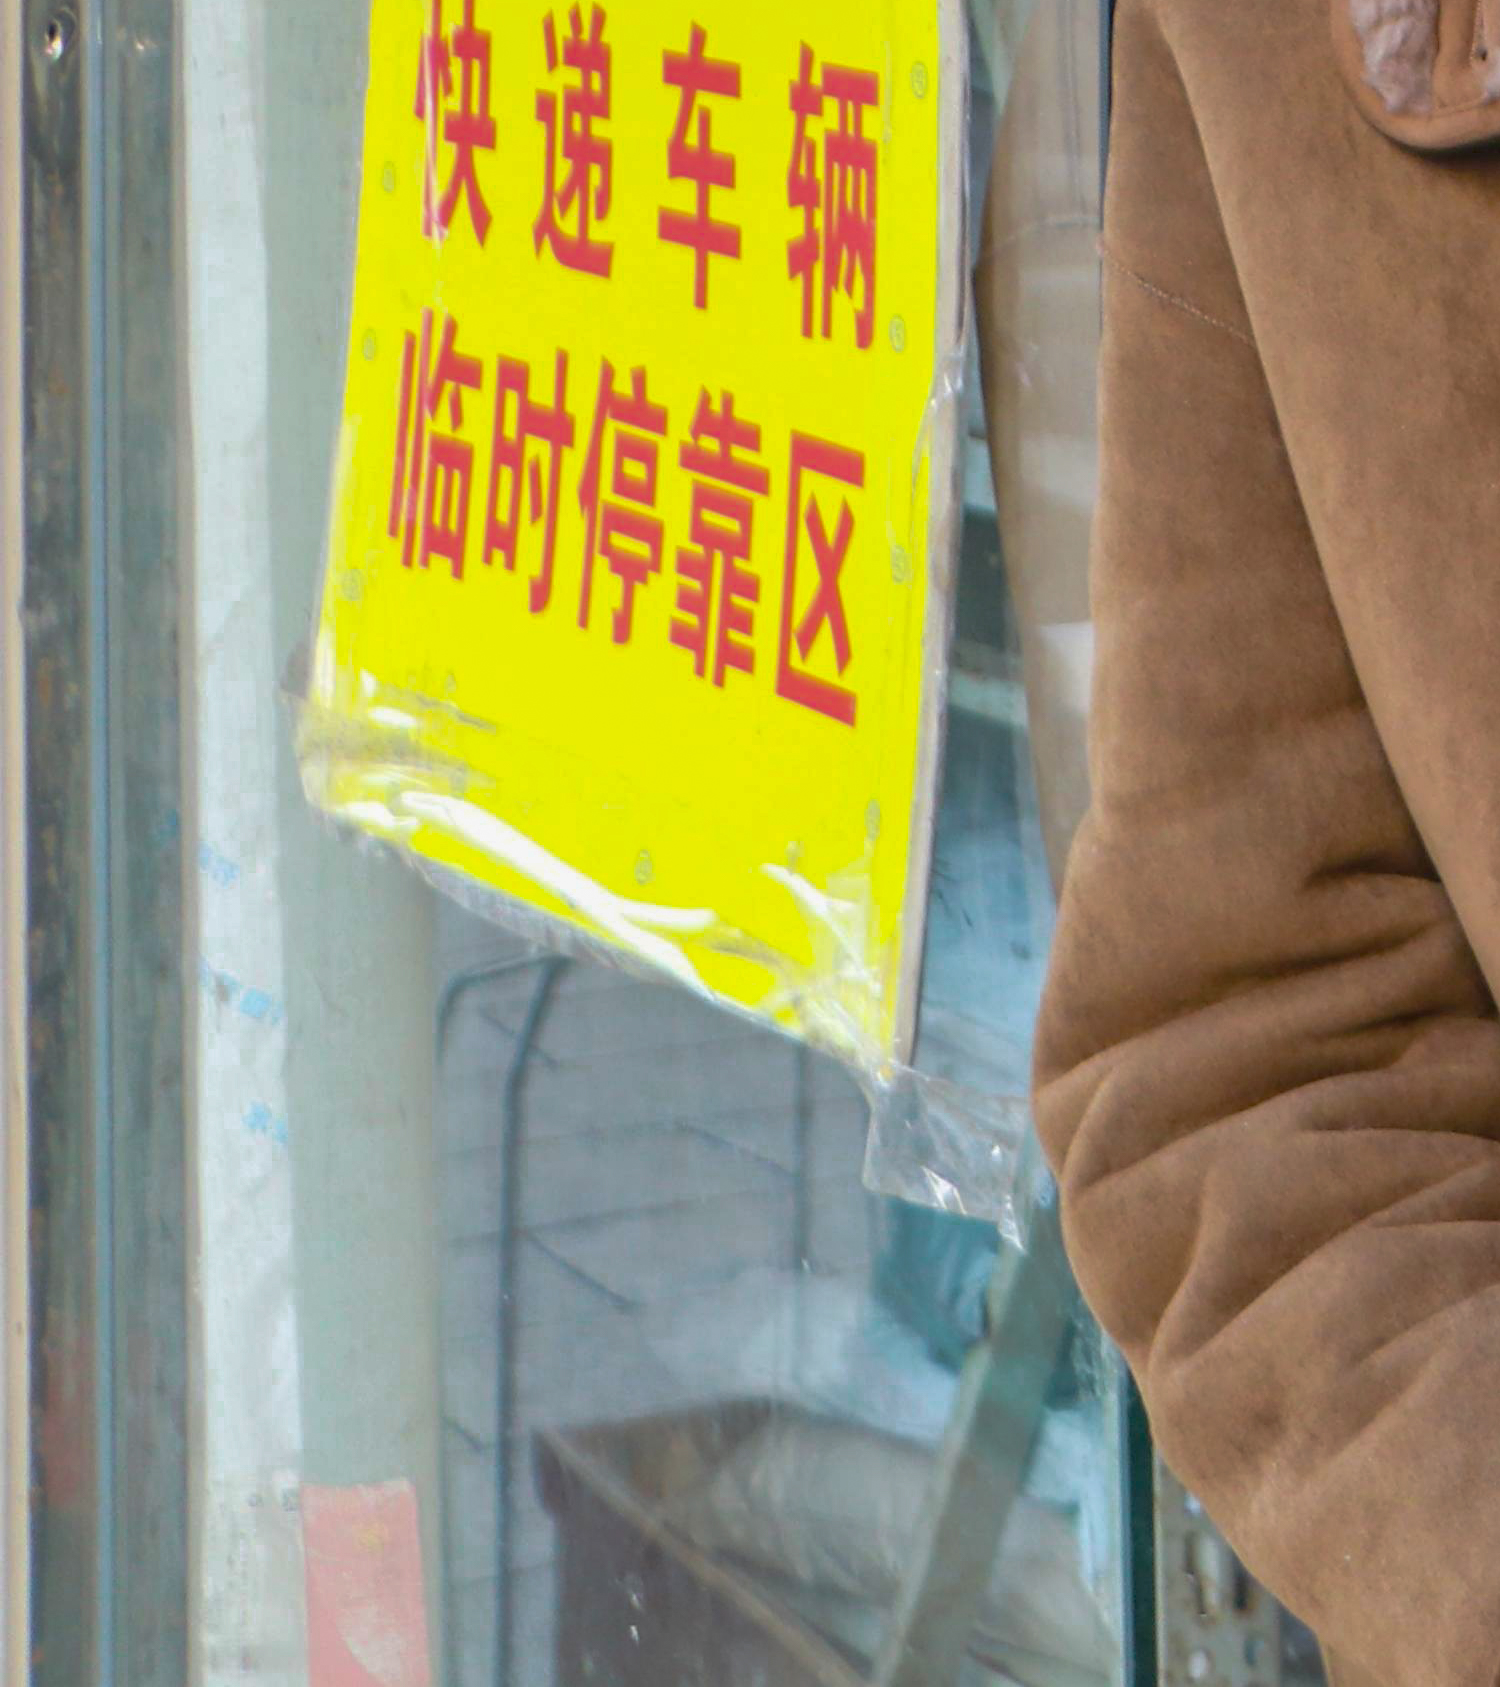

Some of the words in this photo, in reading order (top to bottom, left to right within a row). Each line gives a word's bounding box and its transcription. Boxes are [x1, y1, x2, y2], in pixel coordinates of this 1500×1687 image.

[387, 305, 867, 729] 临时停靠区
